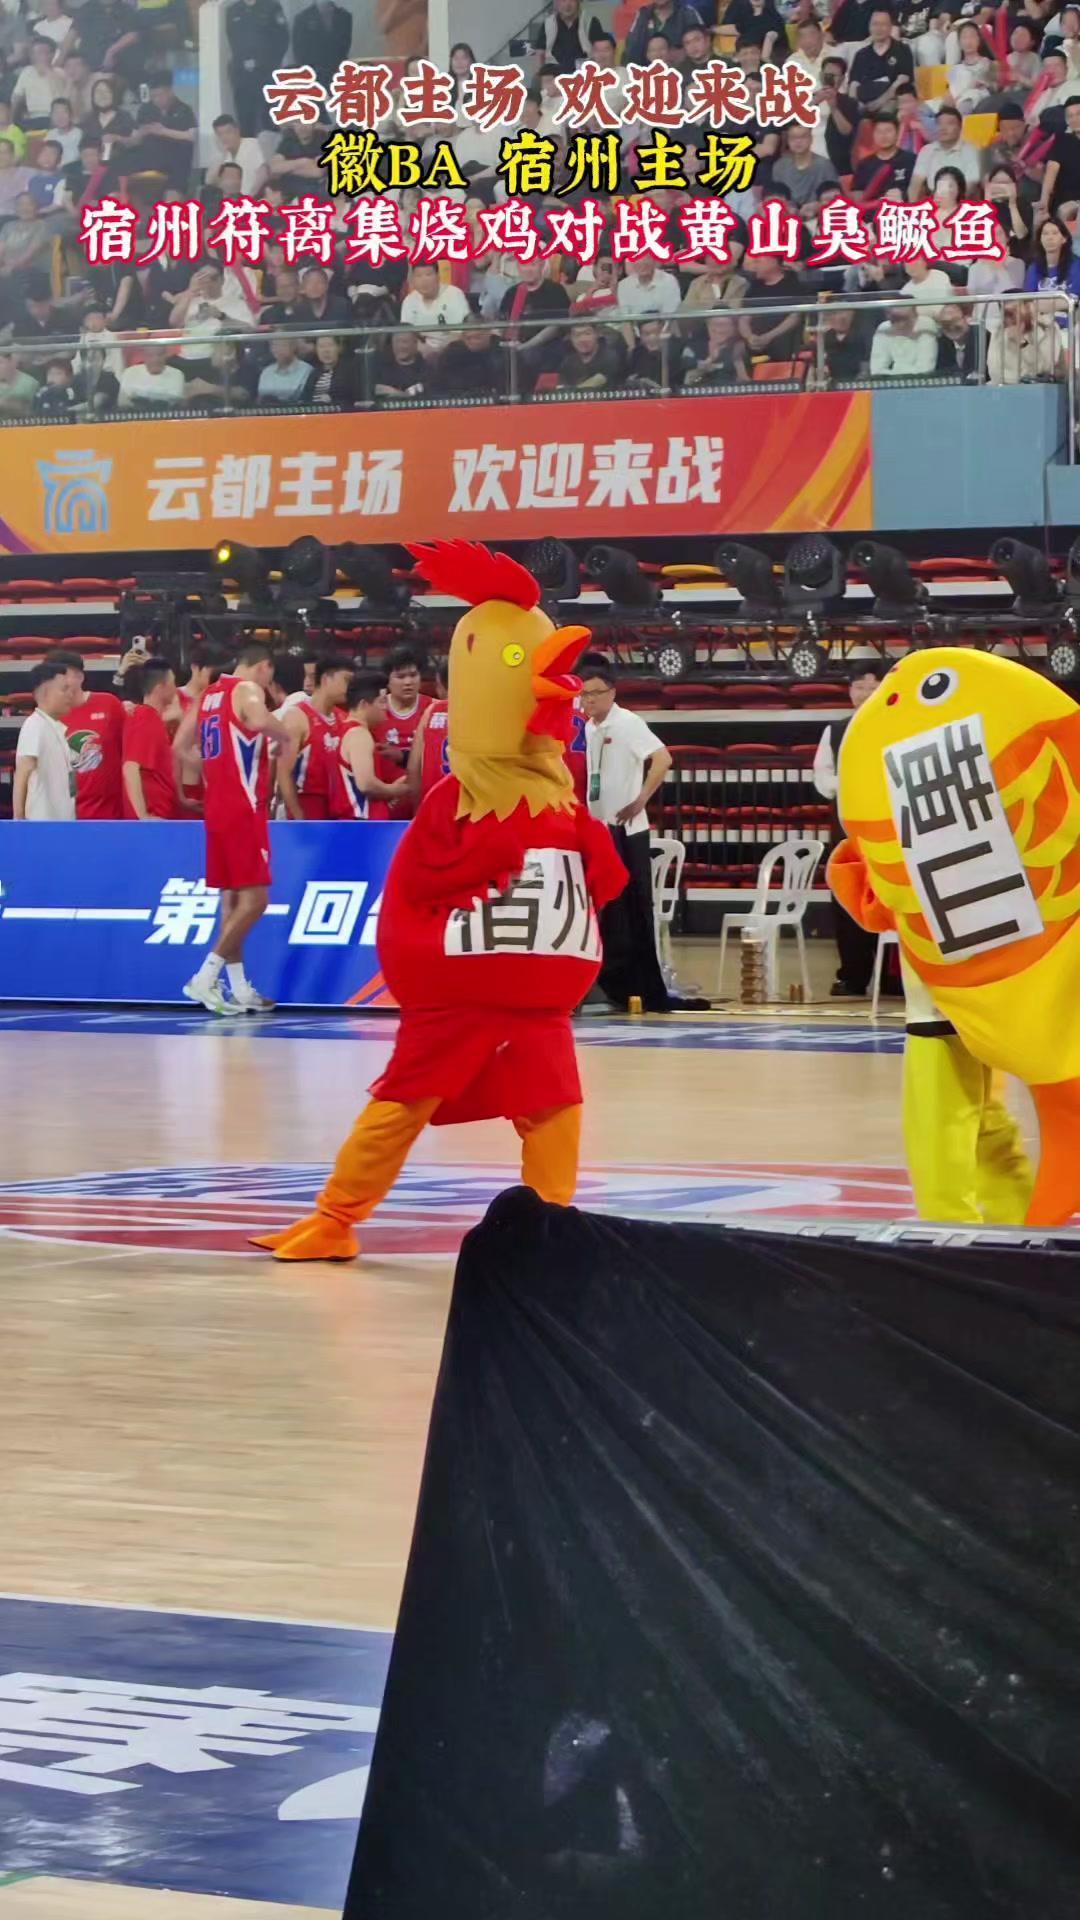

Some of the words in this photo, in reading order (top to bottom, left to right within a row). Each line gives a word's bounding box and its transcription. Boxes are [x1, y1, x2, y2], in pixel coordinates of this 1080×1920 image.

[147, 448, 403, 522] 云都主场
[448, 434, 725, 514] 欢迎来战
[883, 722, 1026, 956] 黄山
